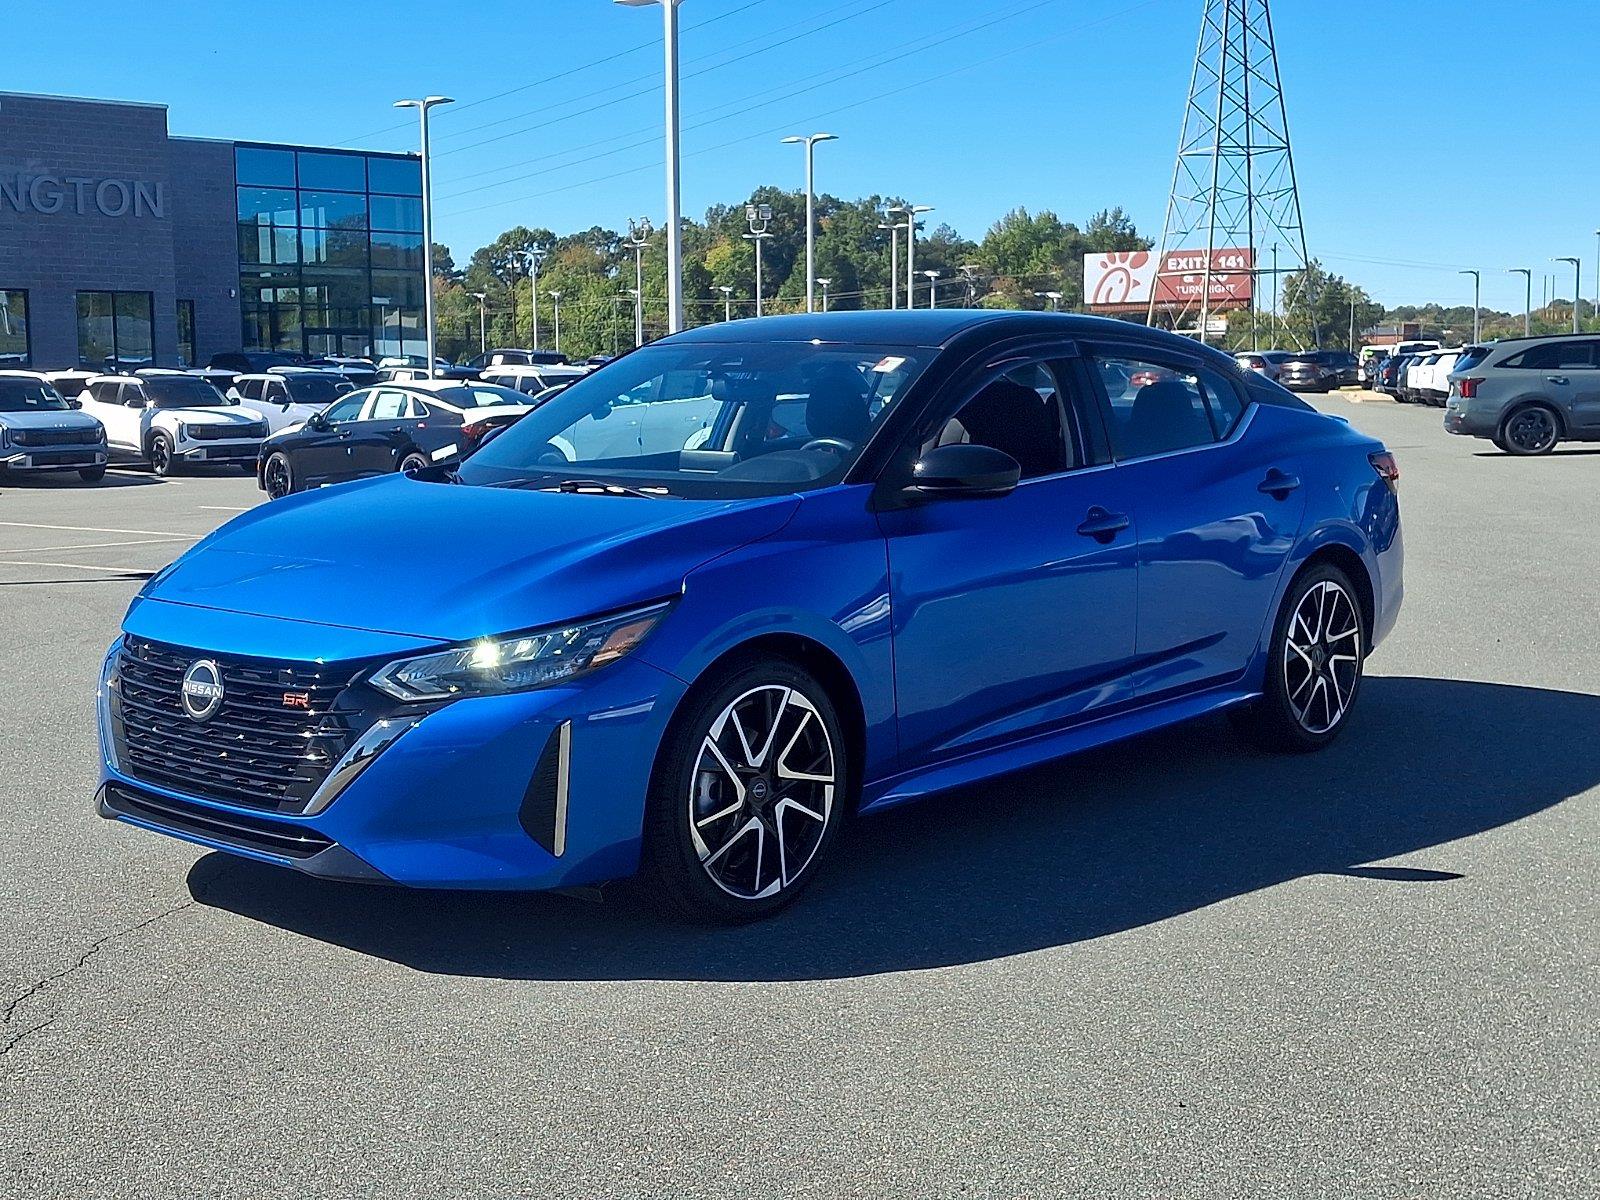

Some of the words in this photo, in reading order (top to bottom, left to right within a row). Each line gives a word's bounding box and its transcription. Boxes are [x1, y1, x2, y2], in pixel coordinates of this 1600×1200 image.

[0, 174, 165, 218] NGTON
[1218, 255, 1244, 268] 141
[1175, 285, 1203, 294] TURN
[1208, 284, 1235, 293] RIGHT
[183, 681, 222, 697] NISSAN
[282, 692, 309, 708] SR
